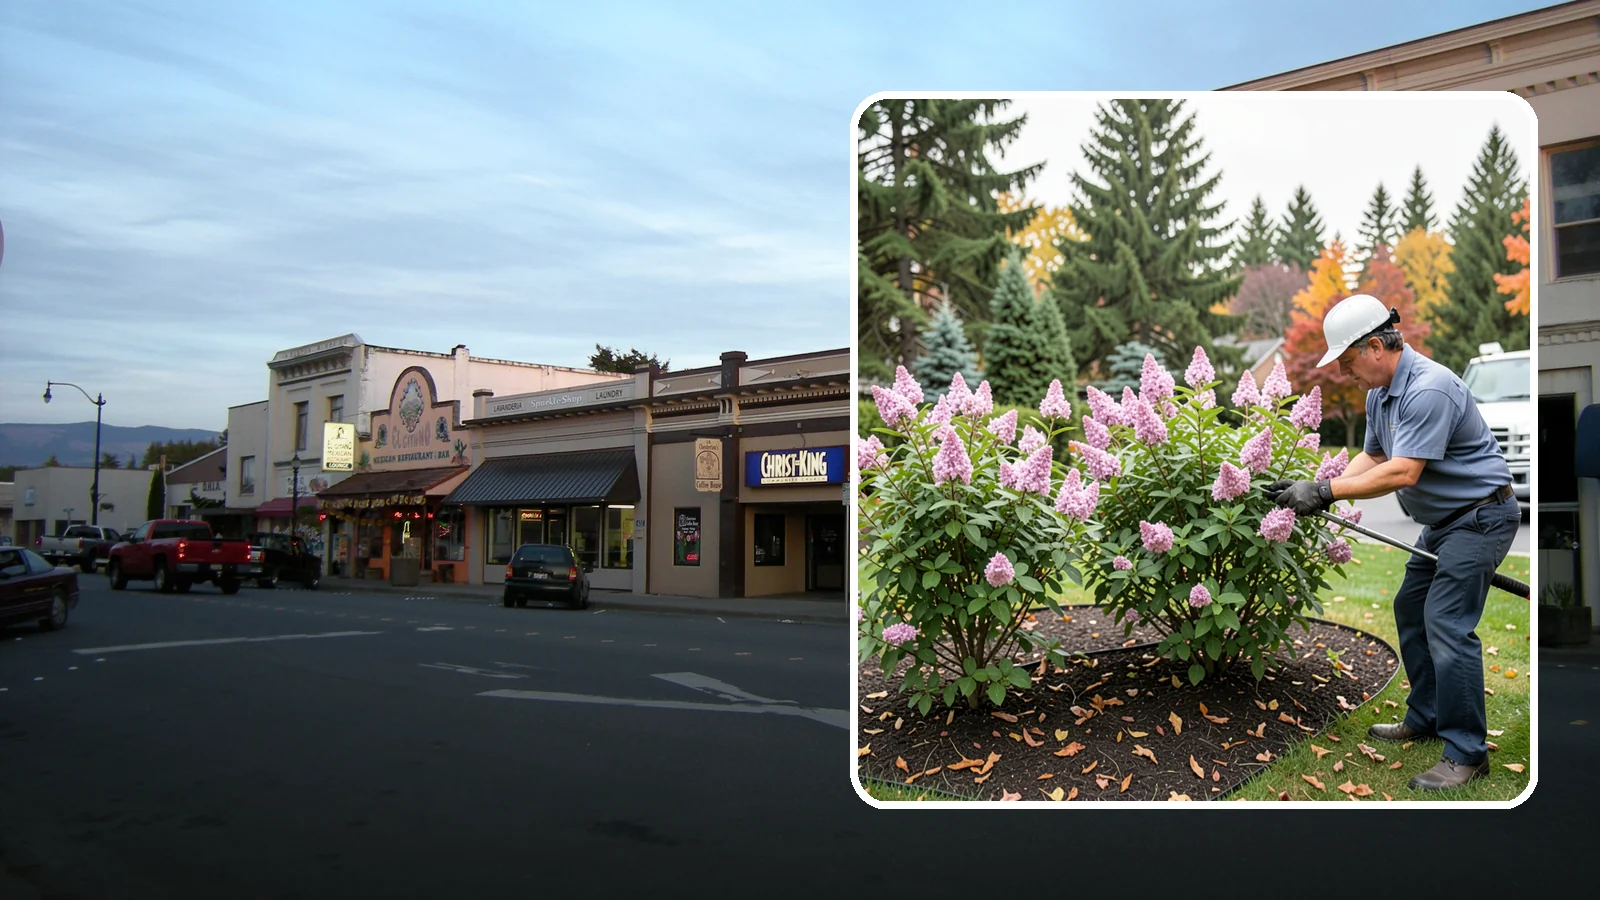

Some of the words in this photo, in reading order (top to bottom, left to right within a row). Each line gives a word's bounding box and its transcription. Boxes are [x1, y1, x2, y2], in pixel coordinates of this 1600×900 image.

[595, 389, 623, 400] LAUNDRY
[493, 402, 522, 413] LAVANDERIA
[530, 398, 561, 409] Sparkle
[561, 395, 582, 405] Shop
[392, 426, 402, 449] EL
[373, 455, 396, 464] MEXICAN
[397, 451, 433, 462] RESTAURANT
[438, 450, 450, 459] BAR
[760, 452, 797, 478] CHRIST
[799, 450, 827, 476] KING
[696, 481, 709, 489] Coffee
